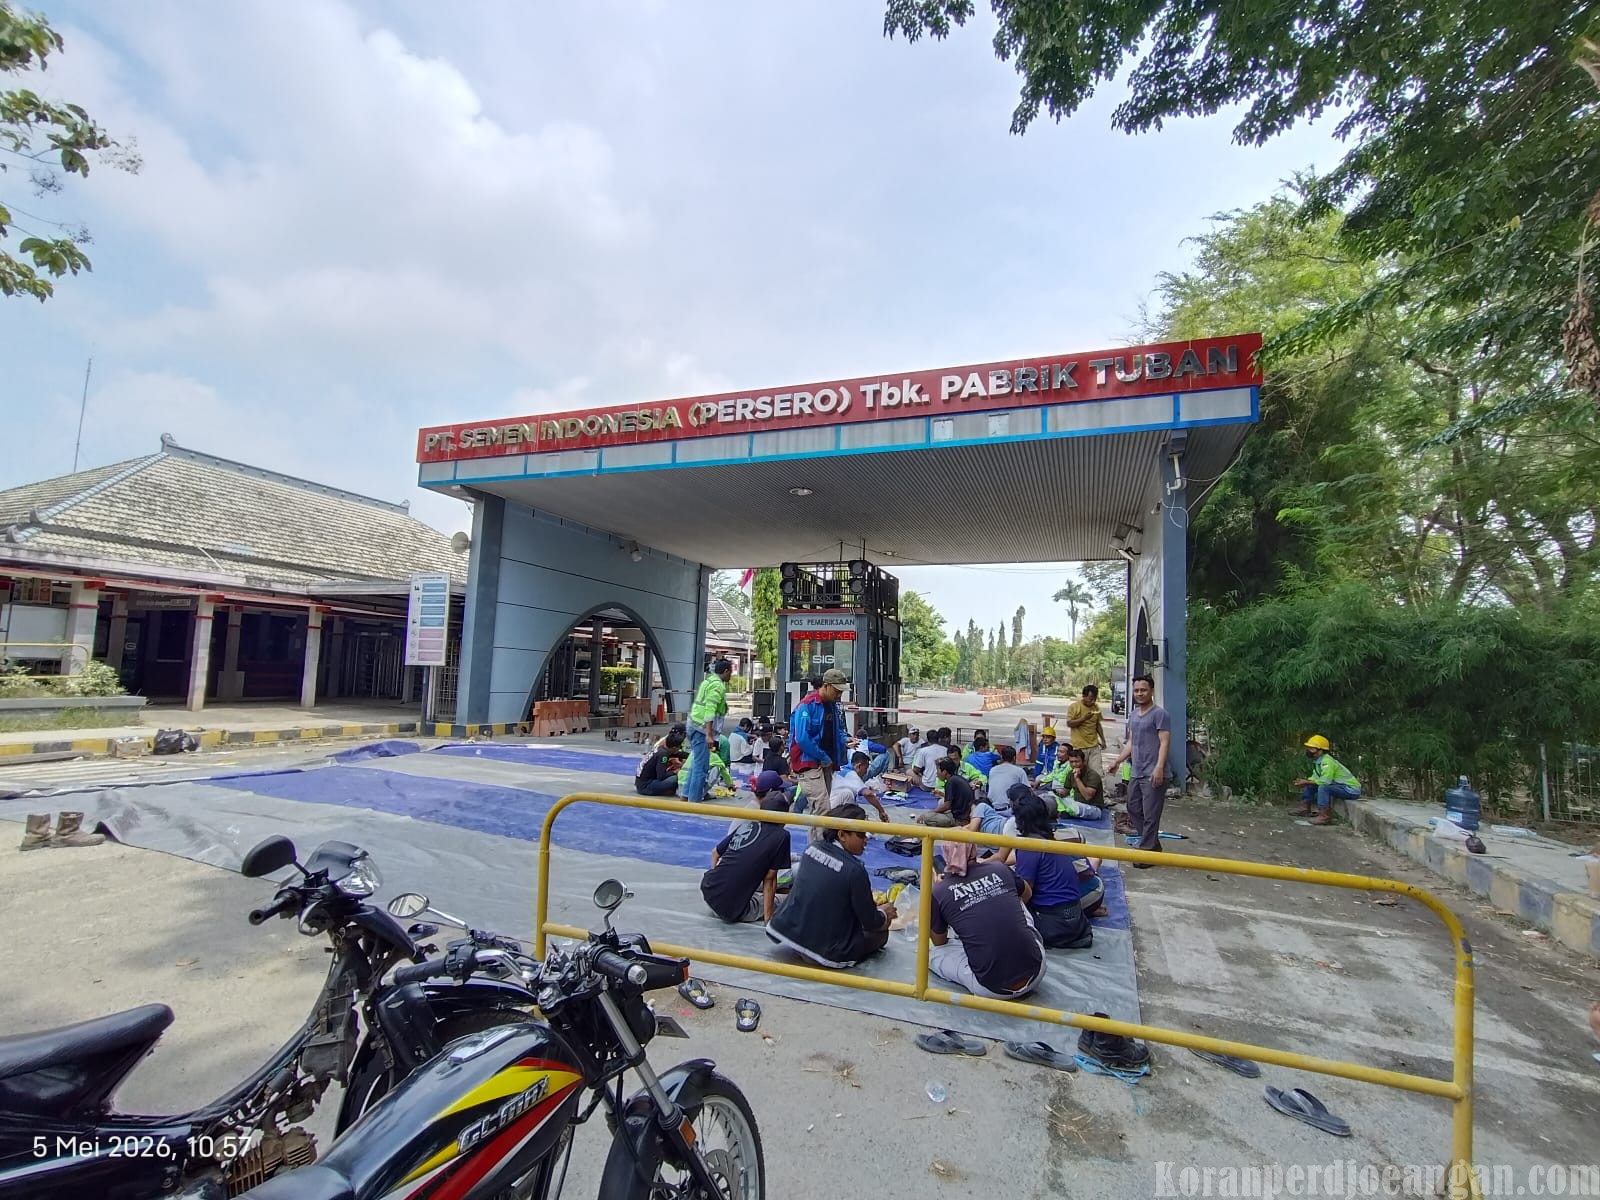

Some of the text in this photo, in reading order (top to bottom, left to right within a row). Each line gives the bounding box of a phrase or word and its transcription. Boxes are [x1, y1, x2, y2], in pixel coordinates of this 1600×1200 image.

[424, 432, 456, 452] PT.
[459, 423, 536, 449] SEMEN
[541, 405, 682, 440] INDONESIA
[688, 386, 851, 427] (PERSERO)
[860, 379, 931, 408] Tbk.
[1088, 344, 1237, 386] TUBAN
[807, 618, 855, 626] PEMERIKSAAN
[812, 654, 835, 664] SIG
[953, 872, 1003, 902] ANEKA
